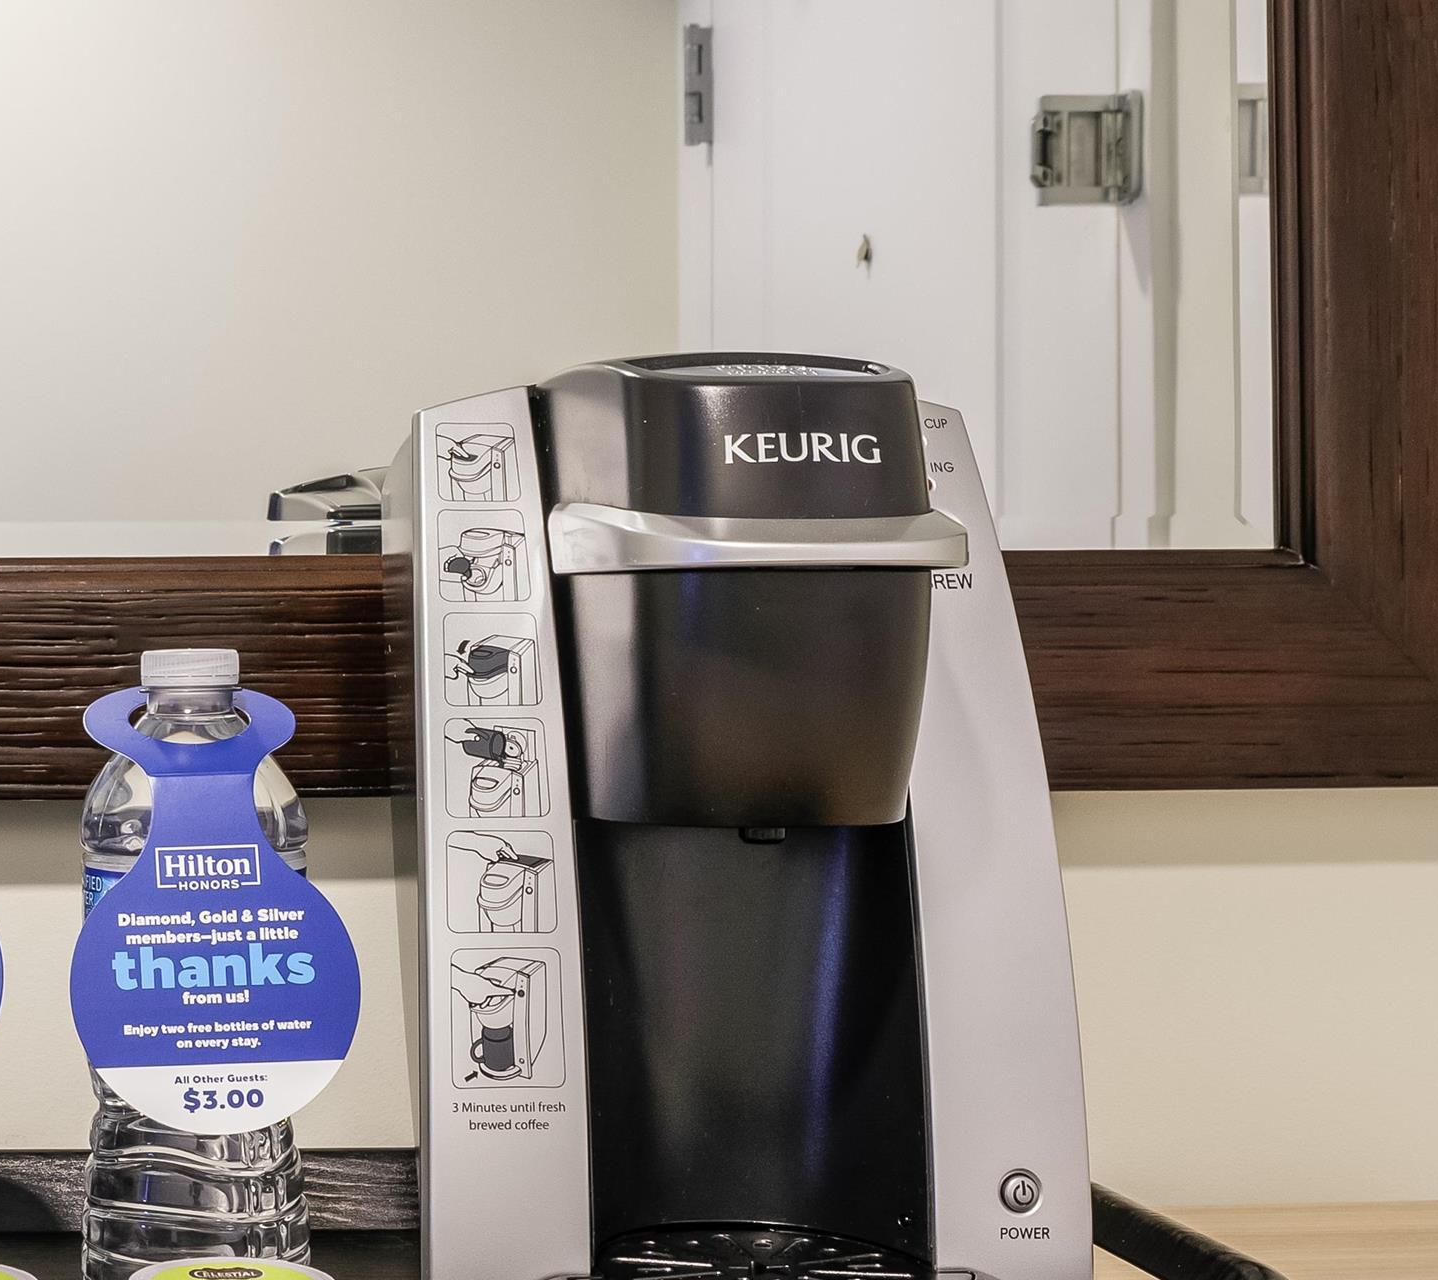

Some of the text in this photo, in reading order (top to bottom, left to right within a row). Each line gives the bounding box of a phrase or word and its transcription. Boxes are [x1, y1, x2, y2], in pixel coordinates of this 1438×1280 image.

[924, 417, 948, 430] CUP
[723, 432, 882, 465] KEURIG
[931, 573, 973, 590] REW
[164, 854, 251, 878] Hilton
[178, 879, 240, 891] HONORS
[117, 907, 305, 927] Diamond, Gold & Silver
[246, 931, 257, 941] a
[259, 926, 299, 941] little
[111, 942, 316, 990] thanks
[182, 989, 250, 1006] from us!
[123, 1020, 312, 1037] Enjoy two free bottles of water
[176, 1037, 261, 1050] on every stay.
[174, 1074, 268, 1085] All Other Guests:
[183, 1087, 264, 1114] $3.00
[452, 1101, 566, 1113] 3 Minutes until fresh
[468, 1119, 550, 1130] brewed coffee
[1000, 1227, 1050, 1240] POWER
[193, 1270, 257, 1279] CELESTIAL
